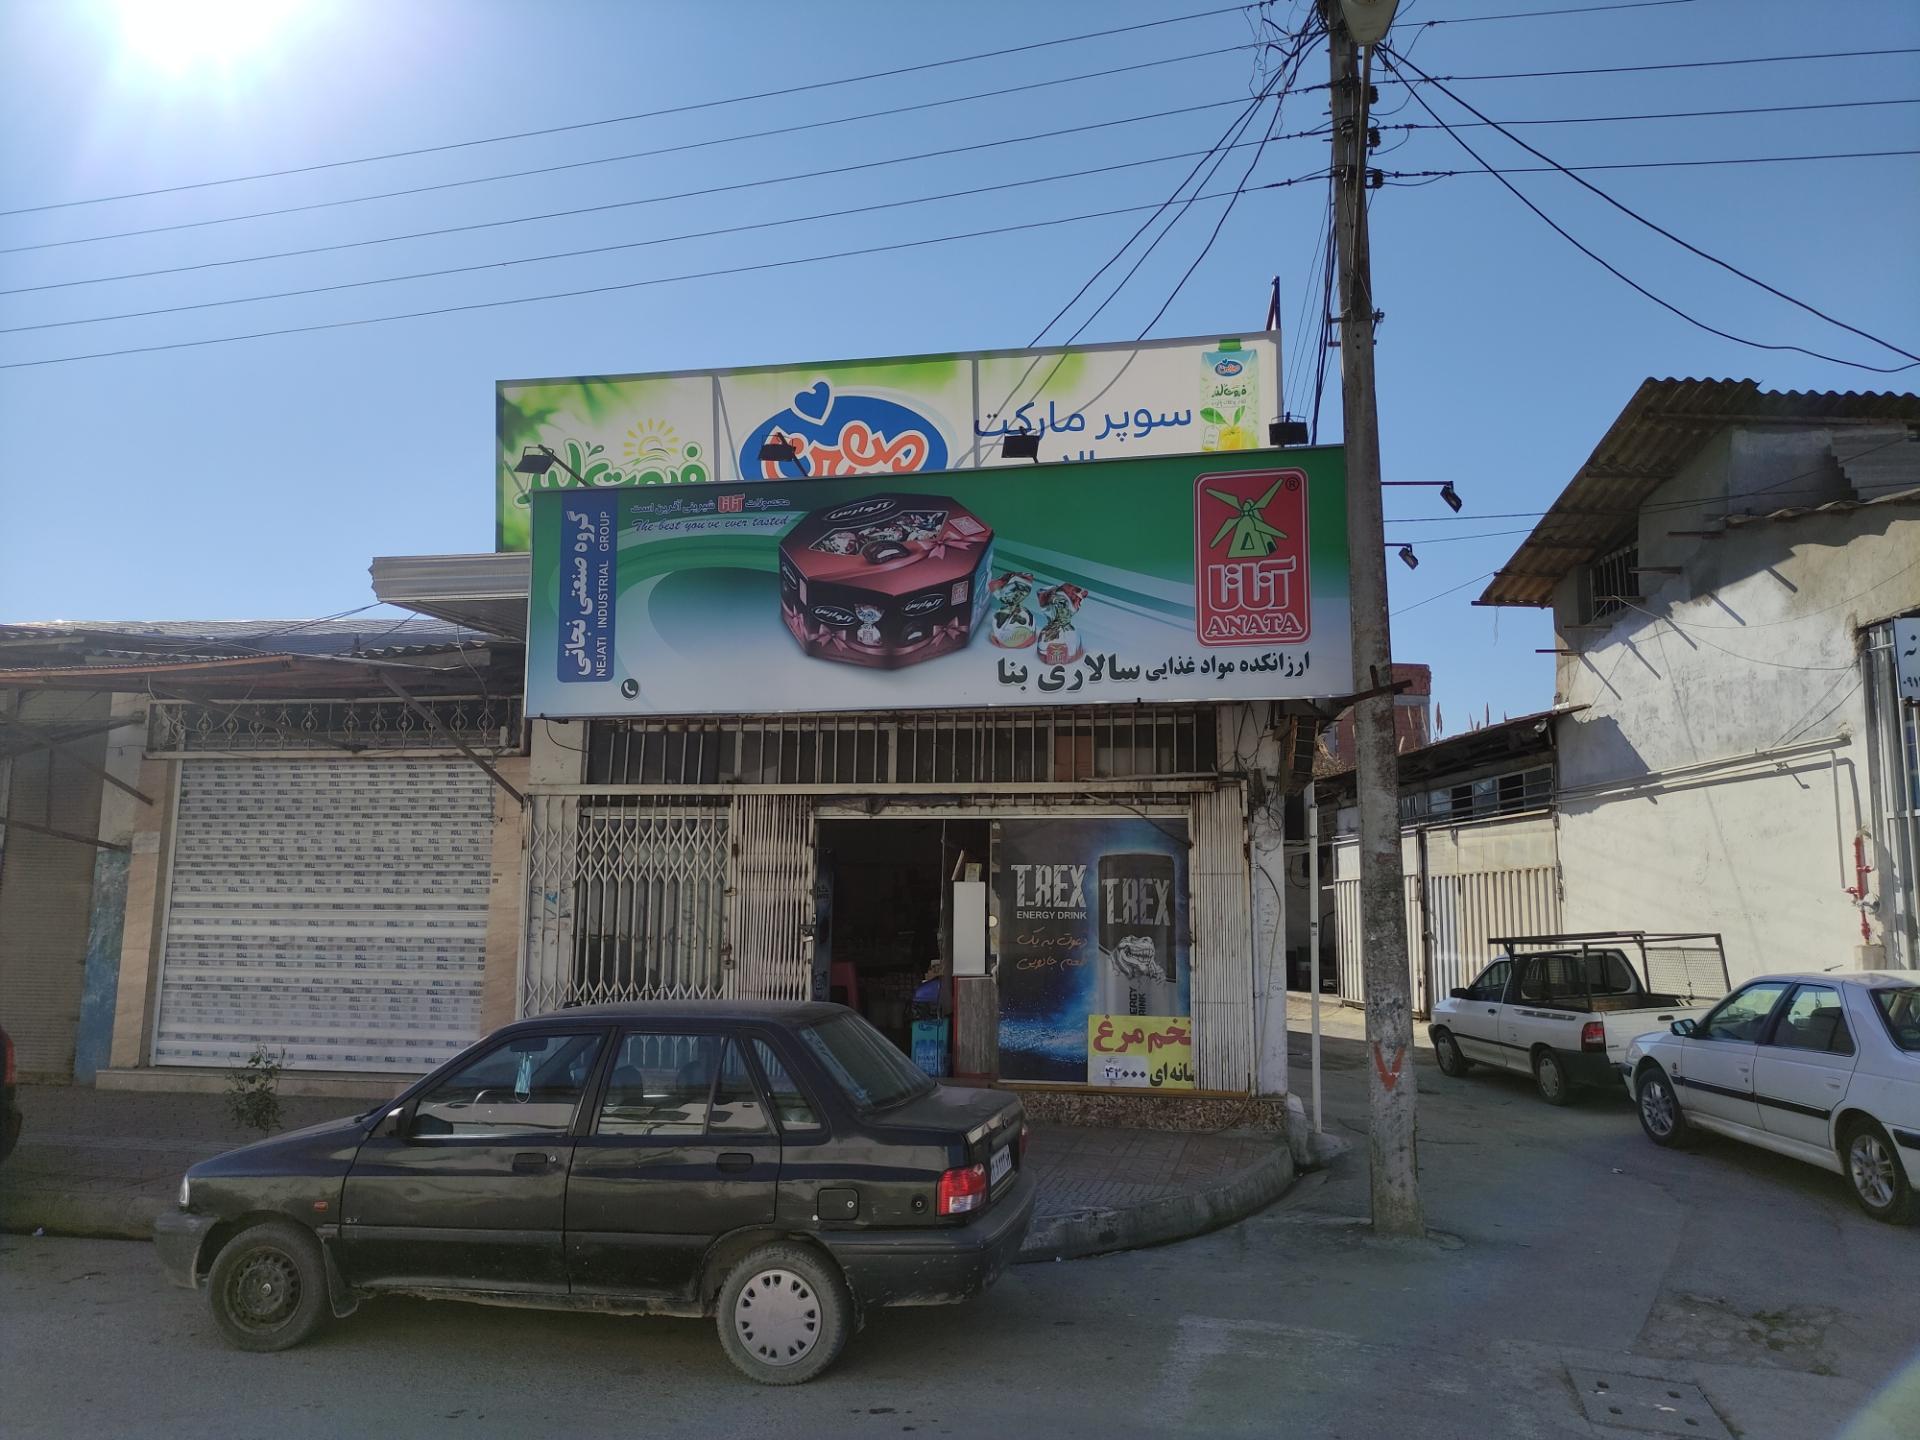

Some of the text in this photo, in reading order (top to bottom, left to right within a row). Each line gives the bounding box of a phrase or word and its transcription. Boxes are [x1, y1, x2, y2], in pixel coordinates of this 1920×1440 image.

[974, 401, 1192, 442] سوپر مارکت
[630, 502, 655, 513] است
[745, 498, 790, 511] محصولات
[632, 519, 655, 532] The
[658, 519, 681, 531] best
[725, 519, 748, 528] ever
[752, 515, 788, 527] tasted
[564, 511, 595, 676] گروه صنعتی نجاتی
[596, 511, 611, 677] NEJATI INDUSTRIAL GROUP
[1205, 614, 1302, 637] ANATA
[998, 657, 1028, 691] بنا
[1038, 651, 1140, 691] سالاری
[1145, 657, 1196, 682] غذایی
[1201, 655, 1235, 679] مواد
[1240, 651, 1310, 677] ارزانکده
[1016, 911, 1087, 920] ENERGY DRINK
[1129, 986, 1138, 1016] ERGY
[1138, 992, 1147, 1016] RINK
[1093, 1014, 1145, 1053] مرغ
